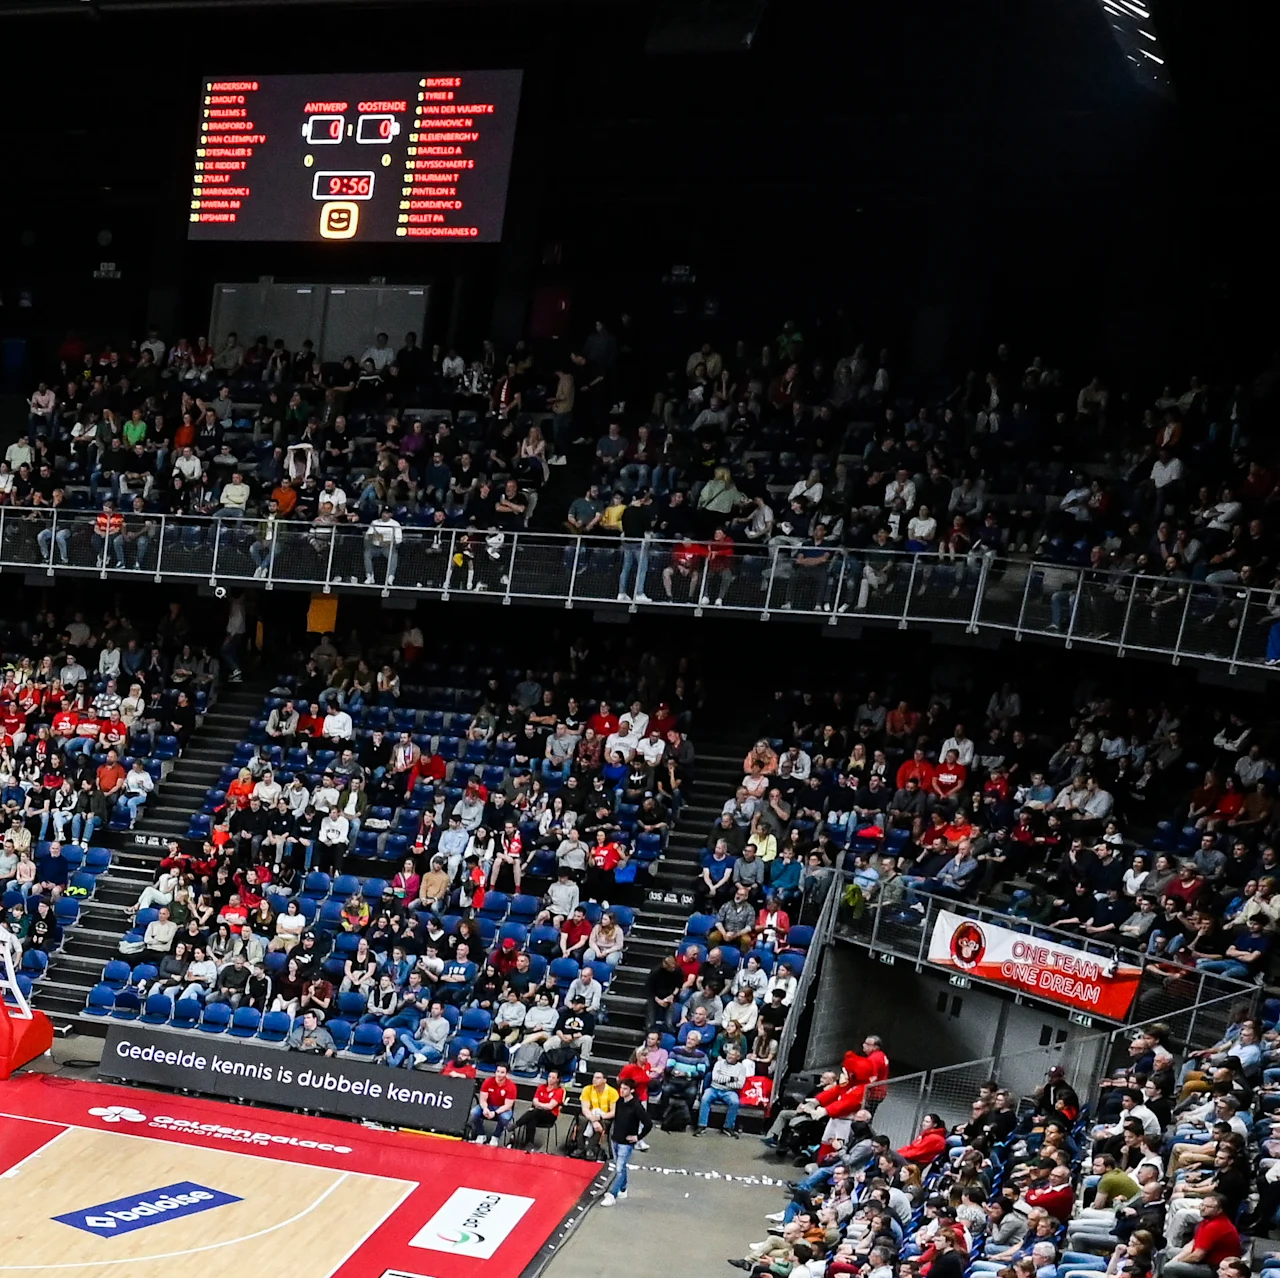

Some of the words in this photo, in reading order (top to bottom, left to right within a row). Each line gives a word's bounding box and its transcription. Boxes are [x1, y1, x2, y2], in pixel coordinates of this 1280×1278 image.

[212, 83, 251, 91] ANDERSON
[427, 78, 454, 87] BUYSSE
[211, 96, 237, 104] SMOUT
[304, 102, 347, 113] ANTWERP
[358, 101, 407, 113] OOSTENDE
[423, 106, 439, 114] VAN
[210, 109, 240, 117] WILLEMS
[208, 122, 245, 130] BRADFORD
[421, 119, 463, 128] JOVANOVIC
[330, 121, 340, 138] 0
[380, 120, 391, 137] 0
[207, 135, 222, 143] VAN
[224, 135, 258, 143] CLEEMPUT
[418, 147, 454, 155] BARCELLO
[304, 155, 313, 167] 0
[381, 154, 391, 167] 0
[416, 160, 466, 169] BUYSSCHAERT
[414, 174, 452, 182] THURMAN
[330, 178, 369, 194] 9:56
[202, 188, 245, 196] MARINKOVIC
[412, 187, 448, 195] PINTELON
[201, 201, 229, 209] MWEMA
[411, 200, 454, 209] DJORDJEVIC
[200, 214, 229, 222] UPSHAW
[409, 214, 432, 223] GILLET
[408, 227, 468, 236] TROISFONTAINES
[1011, 940, 1048, 967] ONE
[1051, 951, 1100, 982] TEAM
[1001, 960, 1038, 985] ONE
[1039, 970, 1101, 1004] DREAM
[116, 1040, 208, 1071] Gedeelde
[211, 1053, 273, 1082] kennis
[277, 1064, 293, 1084] is
[297, 1067, 382, 1098] dubbele
[386, 1082, 454, 1110] kennis
[147, 1121, 207, 1137] CASINO
[108, 1186, 215, 1224] baloise
[463, 1213, 479, 1229] DP
[473, 1194, 501, 1221] WORLD
